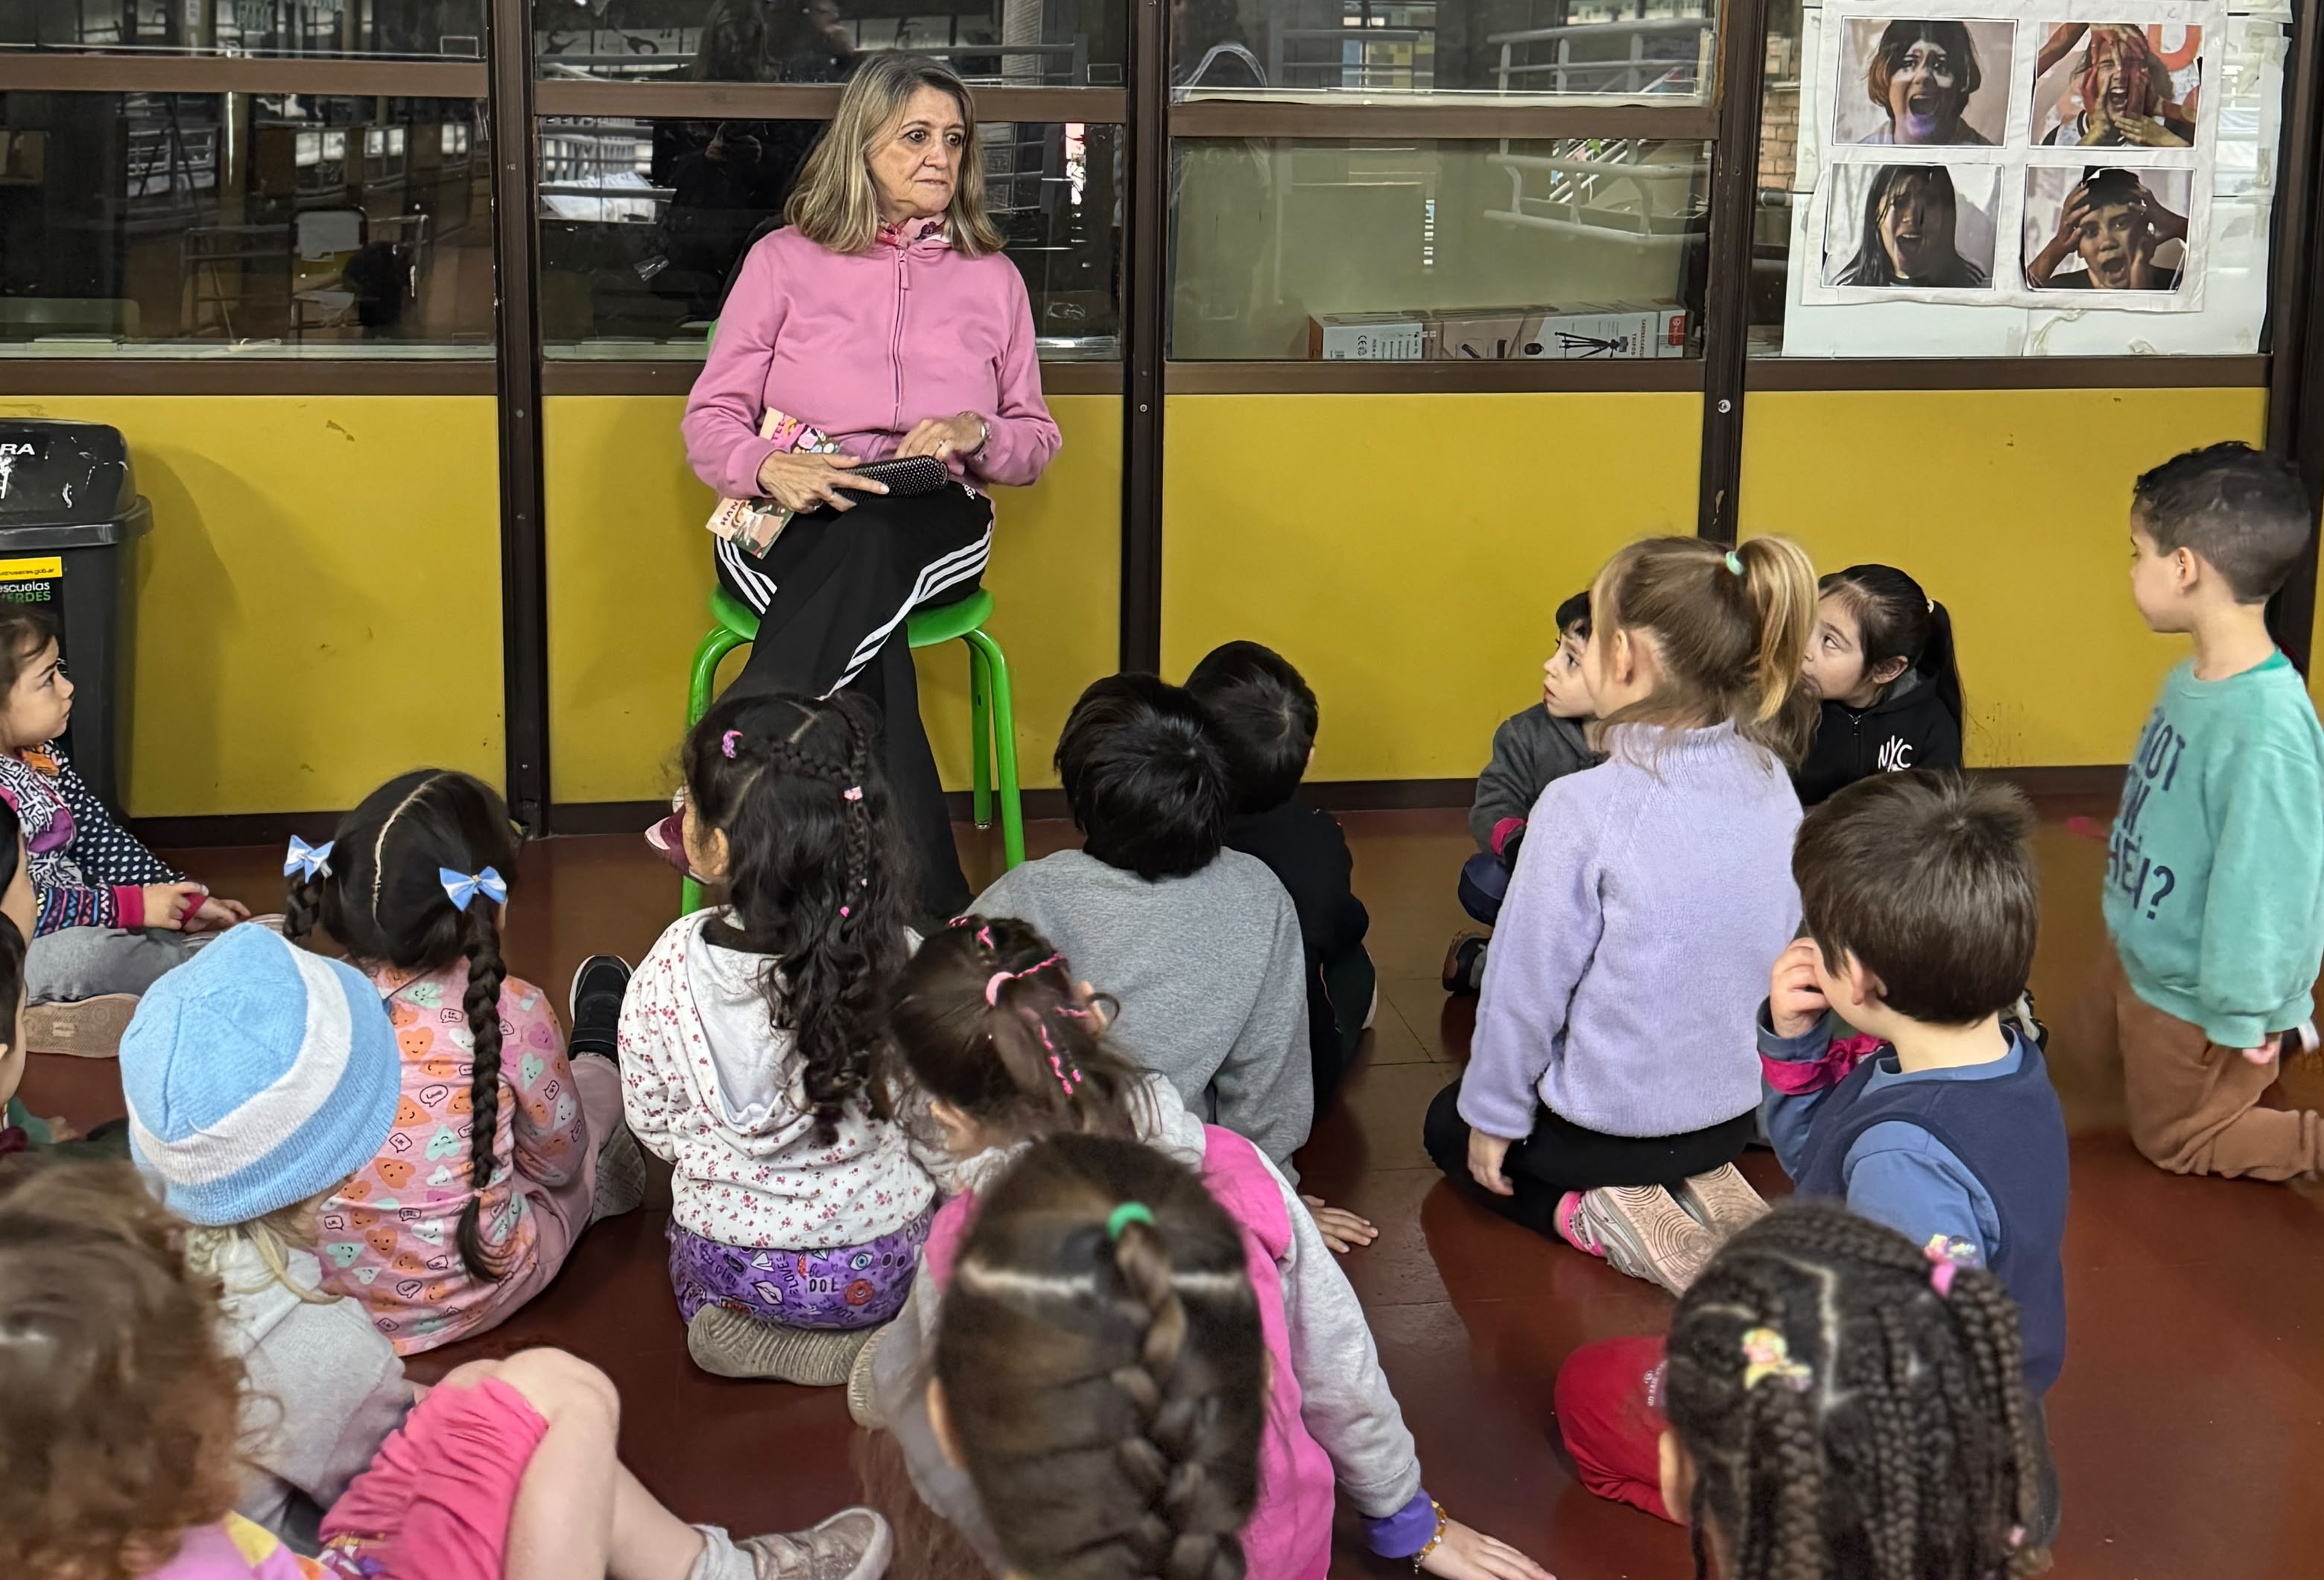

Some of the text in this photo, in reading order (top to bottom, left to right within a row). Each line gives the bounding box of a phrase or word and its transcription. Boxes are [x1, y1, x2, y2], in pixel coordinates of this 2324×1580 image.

[721, 501, 738, 525] HAN
[2, 591, 51, 603] ERDES
[1878, 735, 1913, 772] NYC
[777, 1262, 799, 1289] LOVE
